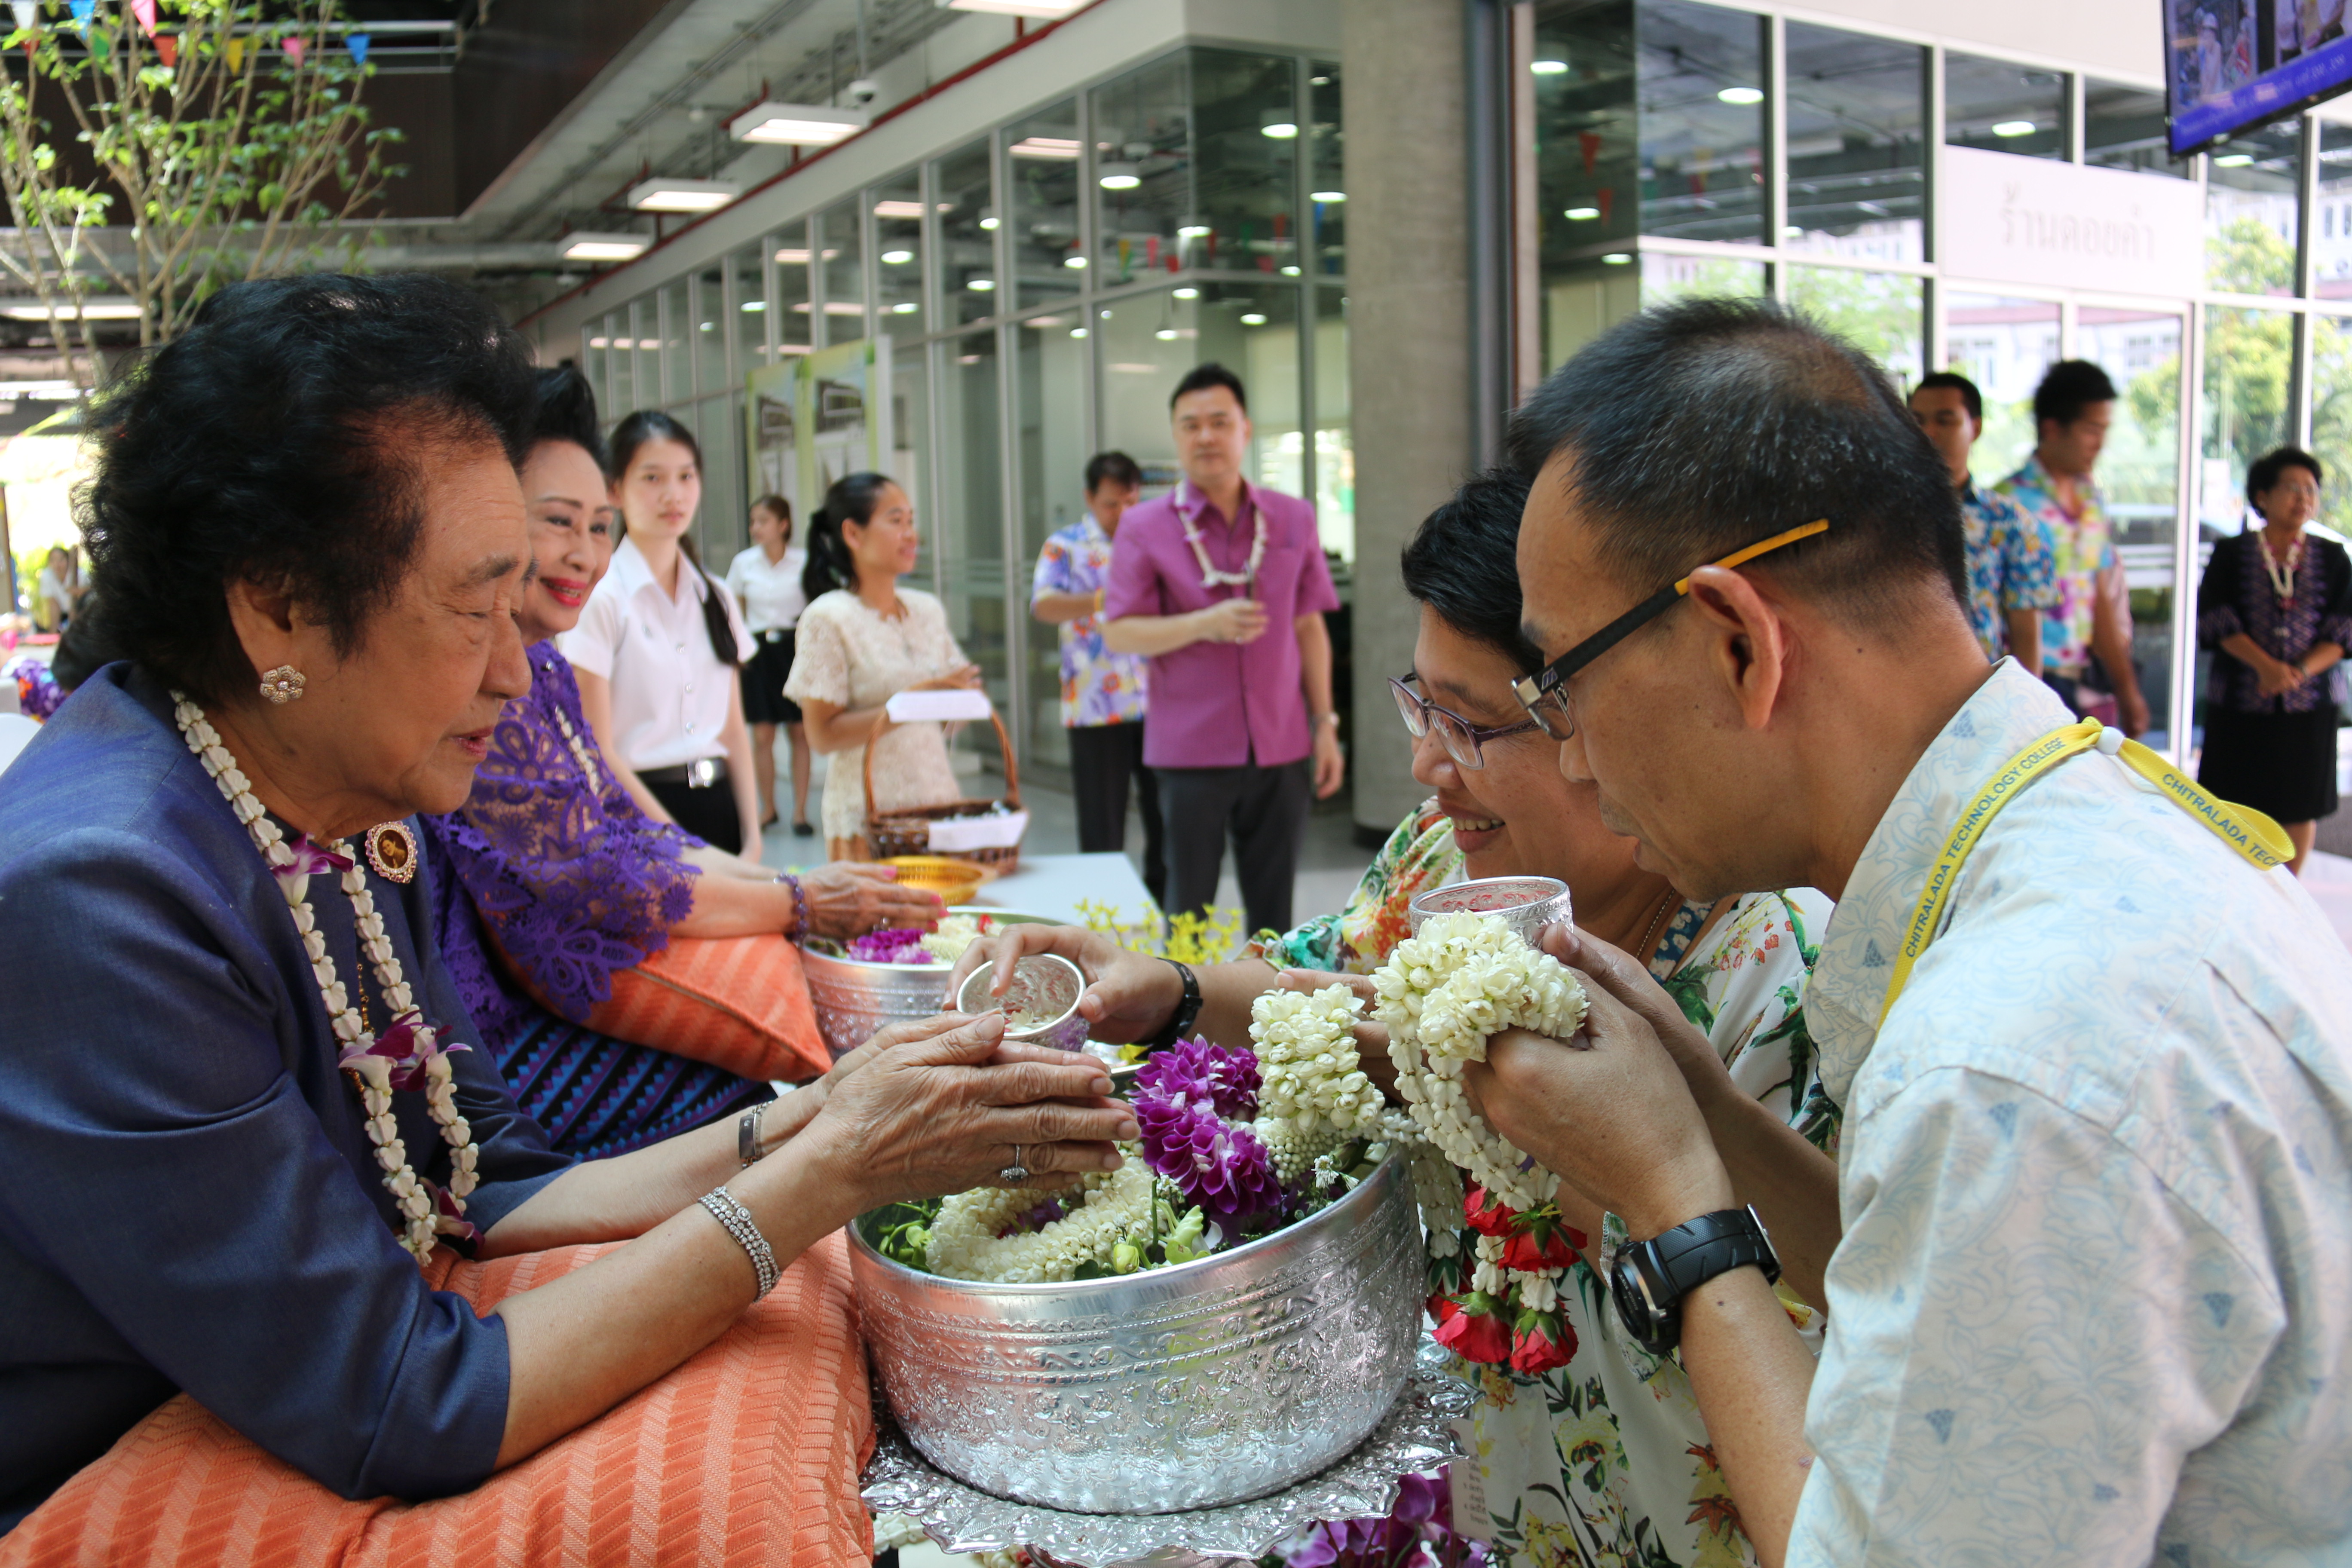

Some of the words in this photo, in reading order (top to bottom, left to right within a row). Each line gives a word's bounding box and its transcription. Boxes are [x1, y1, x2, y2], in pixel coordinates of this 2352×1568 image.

[1906, 864, 1951, 958] CHITRALADA
[1945, 767, 2022, 859] TECHNOLOGY
[2020, 737, 2066, 769] COLLEGE
[2162, 774, 2248, 847] CHITRALADA
